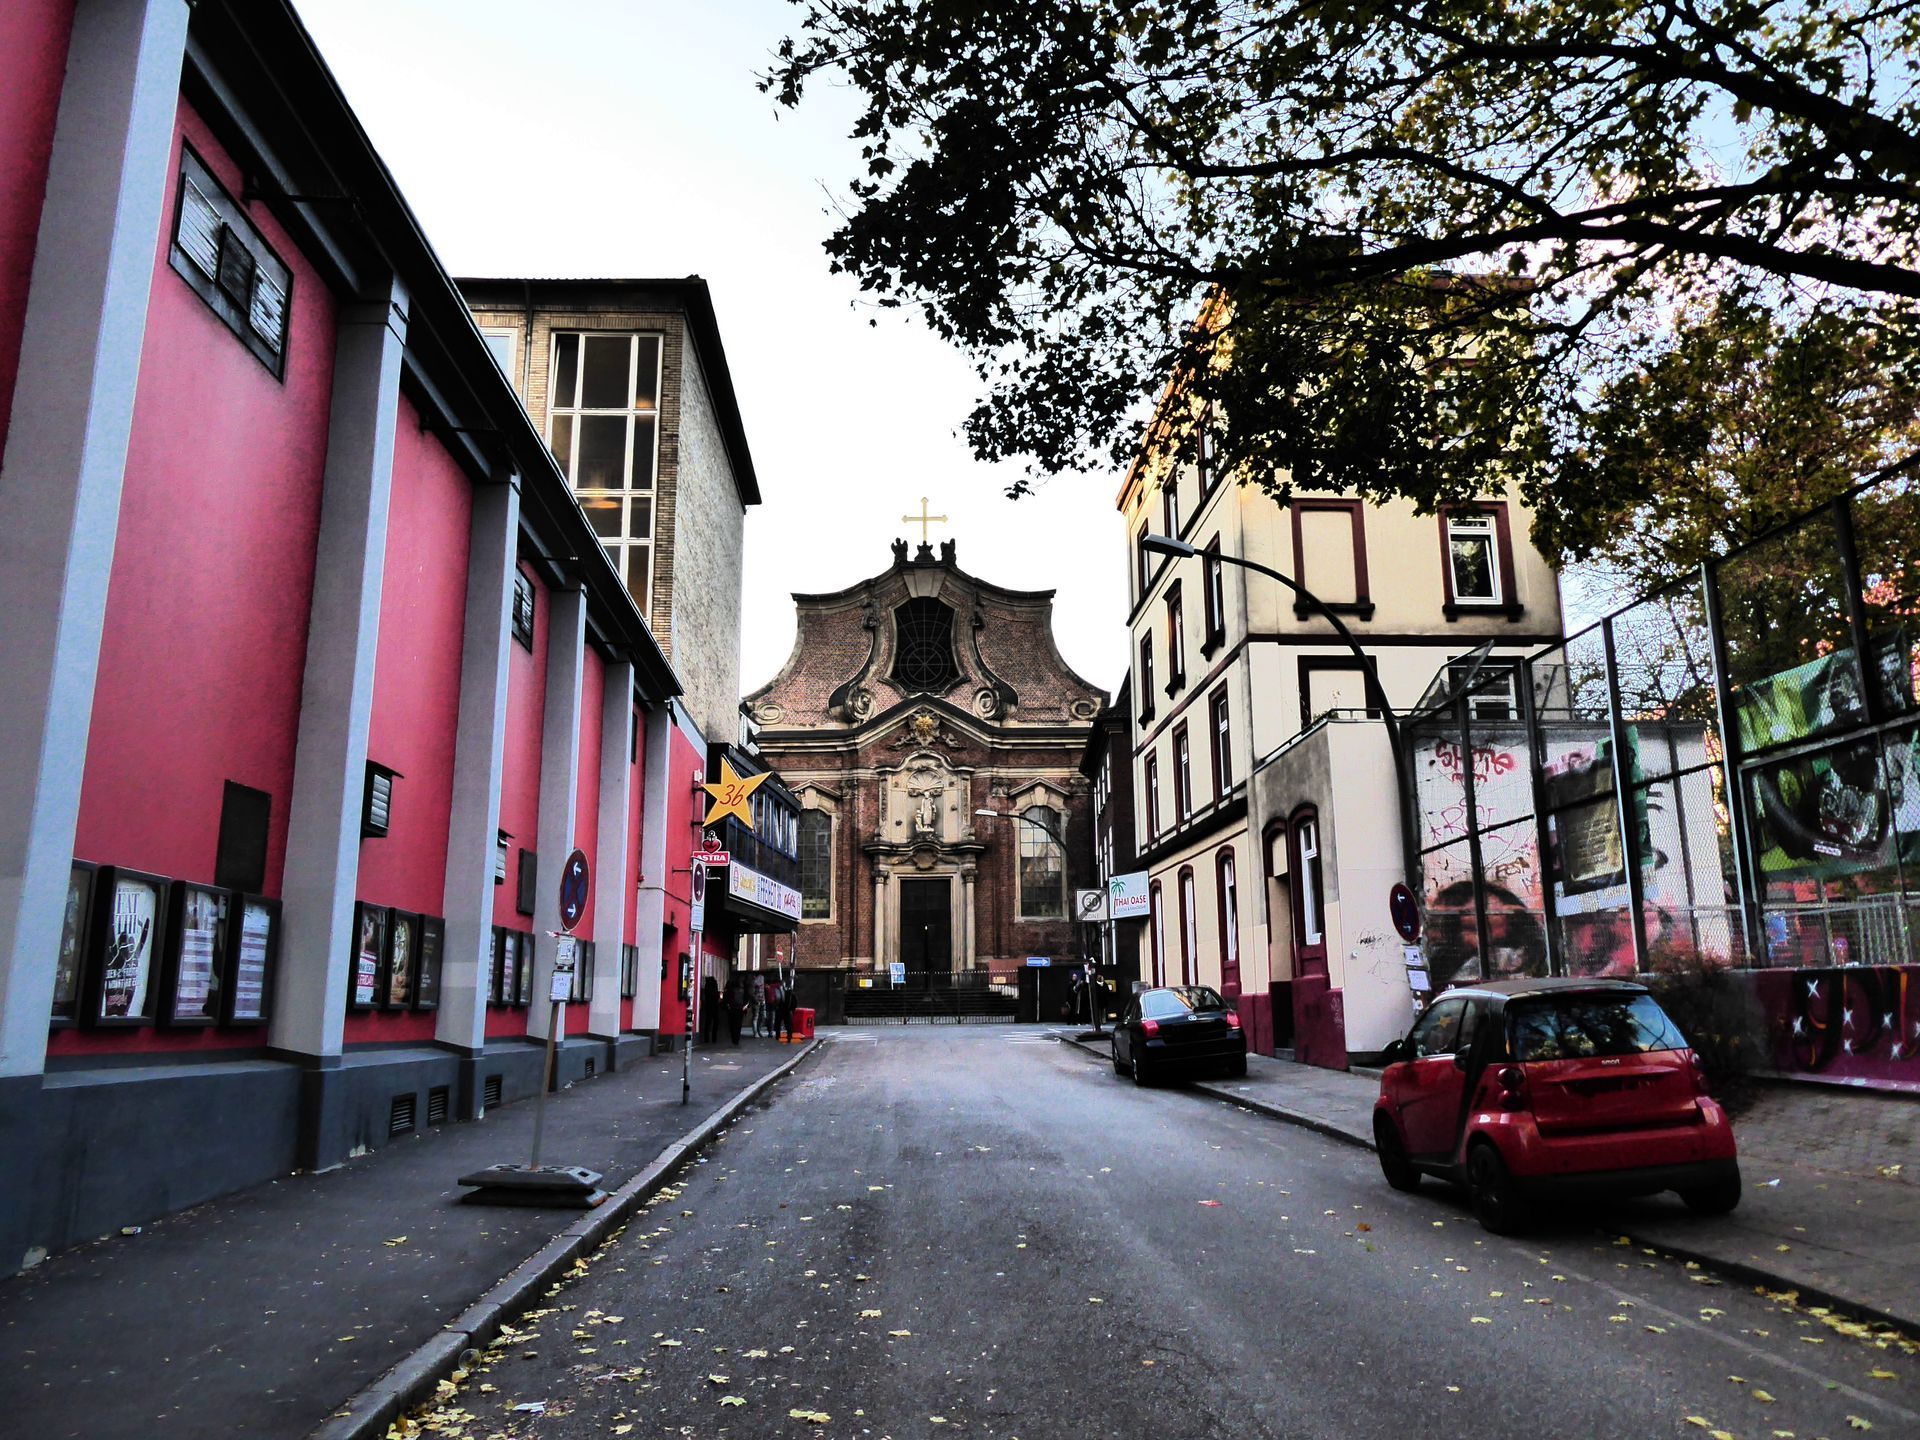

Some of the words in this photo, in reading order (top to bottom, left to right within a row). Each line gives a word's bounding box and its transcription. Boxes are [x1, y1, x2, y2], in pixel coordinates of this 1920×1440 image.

[719, 783, 745, 807] 36
[697, 854, 727, 862] ASTRA
[1114, 897, 1130, 906] THAI
[1130, 894, 1147, 905] OASE
